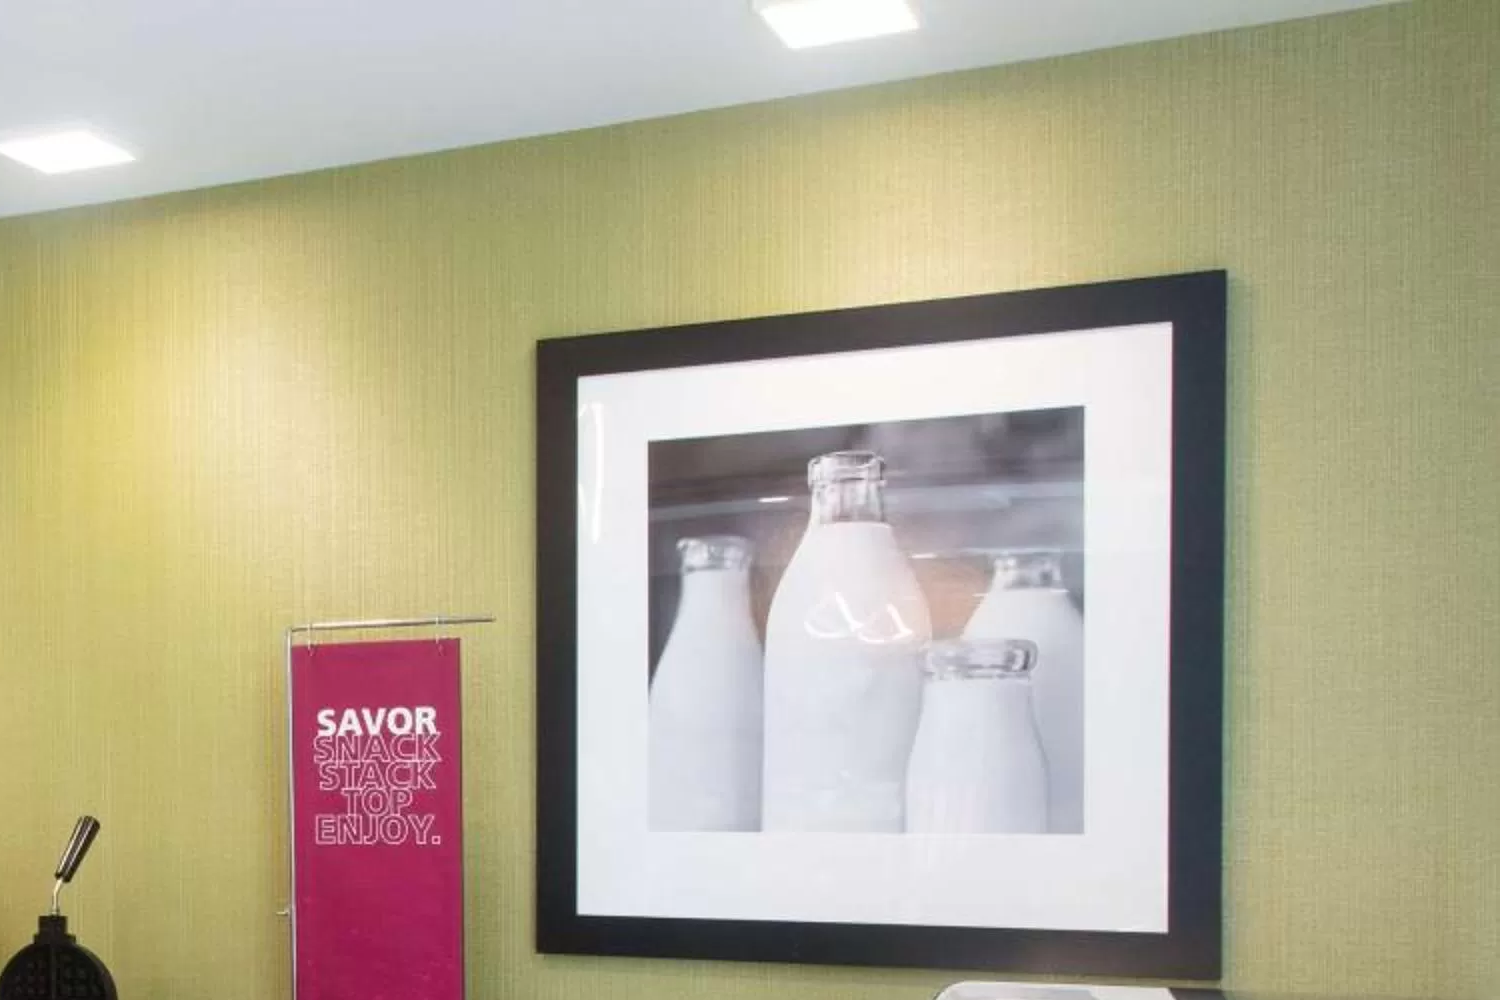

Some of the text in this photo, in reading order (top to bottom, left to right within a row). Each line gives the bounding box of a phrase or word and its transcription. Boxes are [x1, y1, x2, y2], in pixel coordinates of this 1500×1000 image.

[316, 706, 438, 736] SAVOR
[313, 733, 442, 764] SNACK
[319, 760, 437, 790] STACK
[341, 786, 414, 816] TOP
[315, 814, 441, 845] ENJOY.
